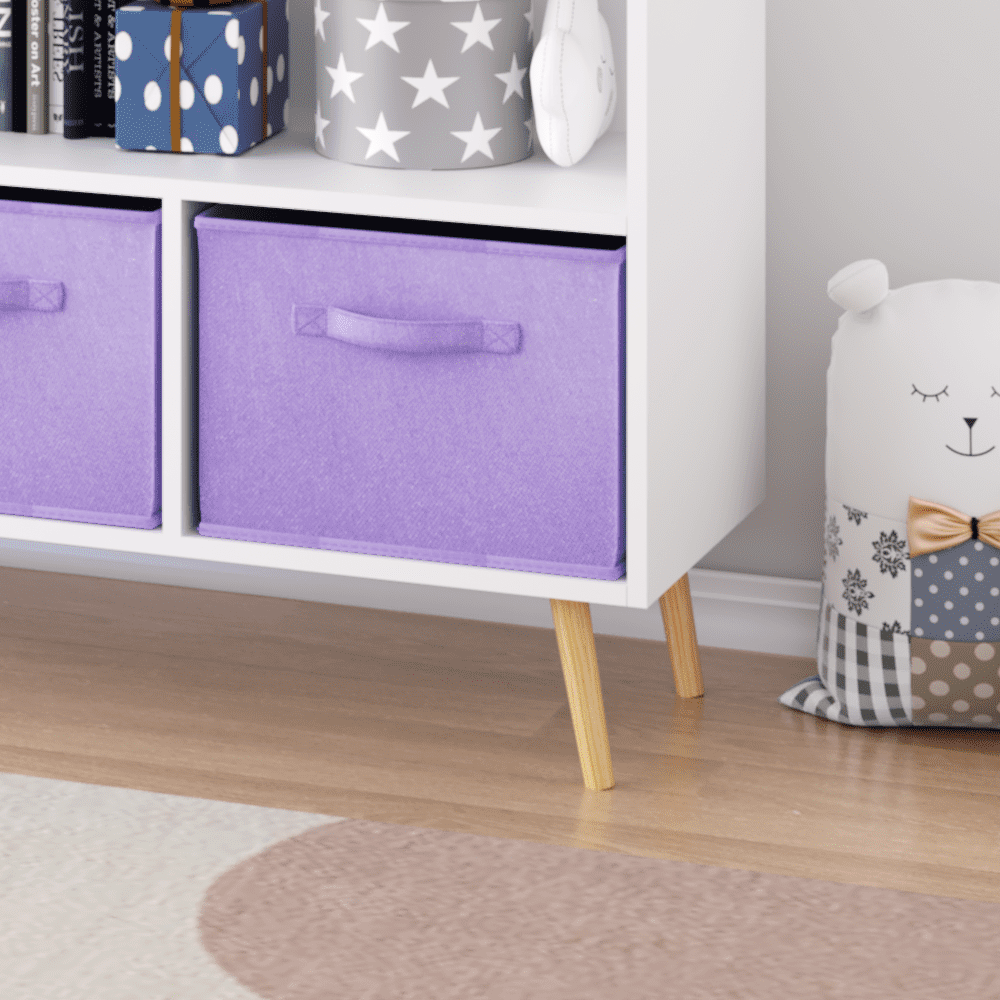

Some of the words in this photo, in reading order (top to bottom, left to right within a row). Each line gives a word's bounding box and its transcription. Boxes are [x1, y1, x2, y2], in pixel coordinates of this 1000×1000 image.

[93, 13, 102, 27] &
[107, 14, 116, 28] &
[30, 41, 39, 59] on
[30, 63, 41, 87] Art
[93, 31, 102, 99] ARTISTS
[107, 31, 116, 100] ARTISTS
